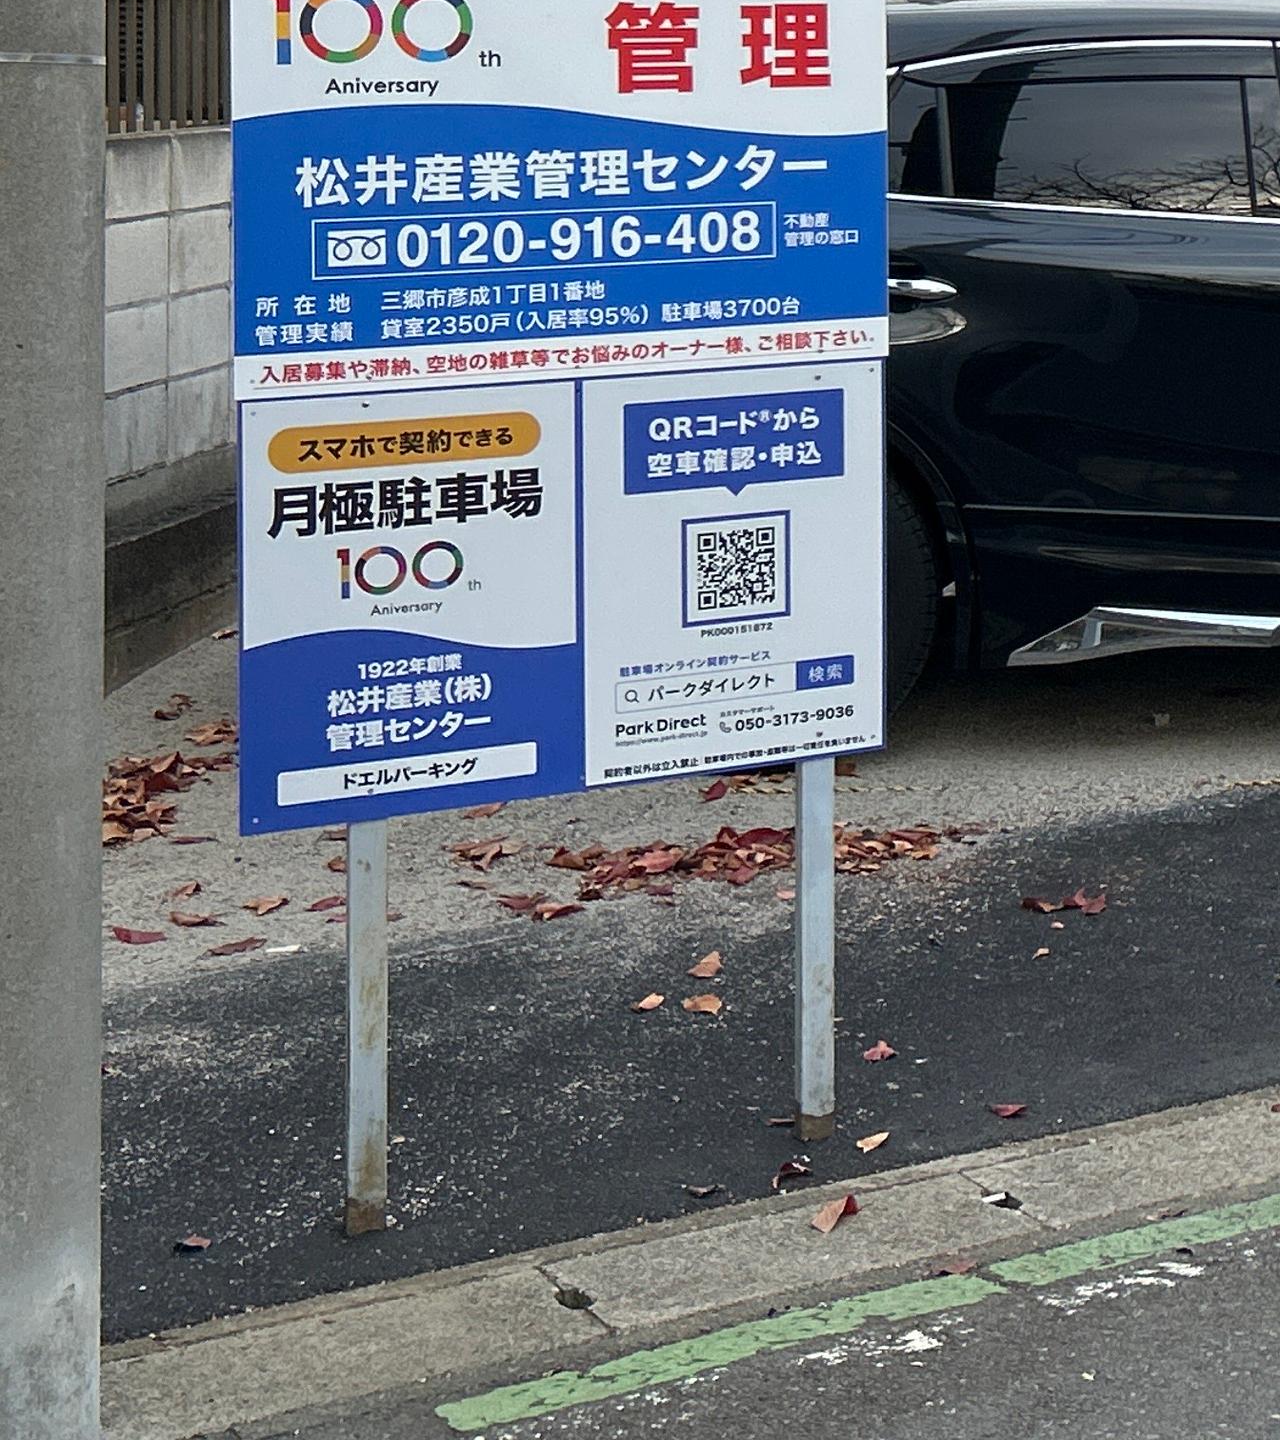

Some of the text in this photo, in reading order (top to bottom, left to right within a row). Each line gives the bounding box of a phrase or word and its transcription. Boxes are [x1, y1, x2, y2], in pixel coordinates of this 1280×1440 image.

[479, 50, 501, 68] th
[605, 1, 831, 94] 管理
[325, 77, 439, 97] Aniversary
[295, 144, 828, 208] 松井産業管理センター
[783, 212, 829, 229] 不動産
[784, 229, 859, 248] 管理の窓口
[396, 210, 761, 268] 0120-916-408
[380, 280, 606, 311] 三郷市彦成1丁目1番地
[255, 321, 353, 347] 管理実績
[661, 296, 801, 324] 駐車場3700台
[298, 427, 514, 463] スマホで契約できる
[647, 440, 822, 478] 空車確認・申込
[267, 467, 543, 539] 月極駐車場
[336, 540, 482, 599] 100 th
[370, 599, 443, 617] Aniversary
[357, 654, 463, 680] 1922年創業
[619, 651, 771, 677] 駐車場オンライン契約サービス
[327, 671, 492, 718] 松井産業(株)
[647, 663, 843, 702] パークダイレクト 検索
[325, 711, 492, 753] 管理センター
[615, 714, 707, 738] Park Direct
[735, 705, 854, 732] 050-3173-9036
